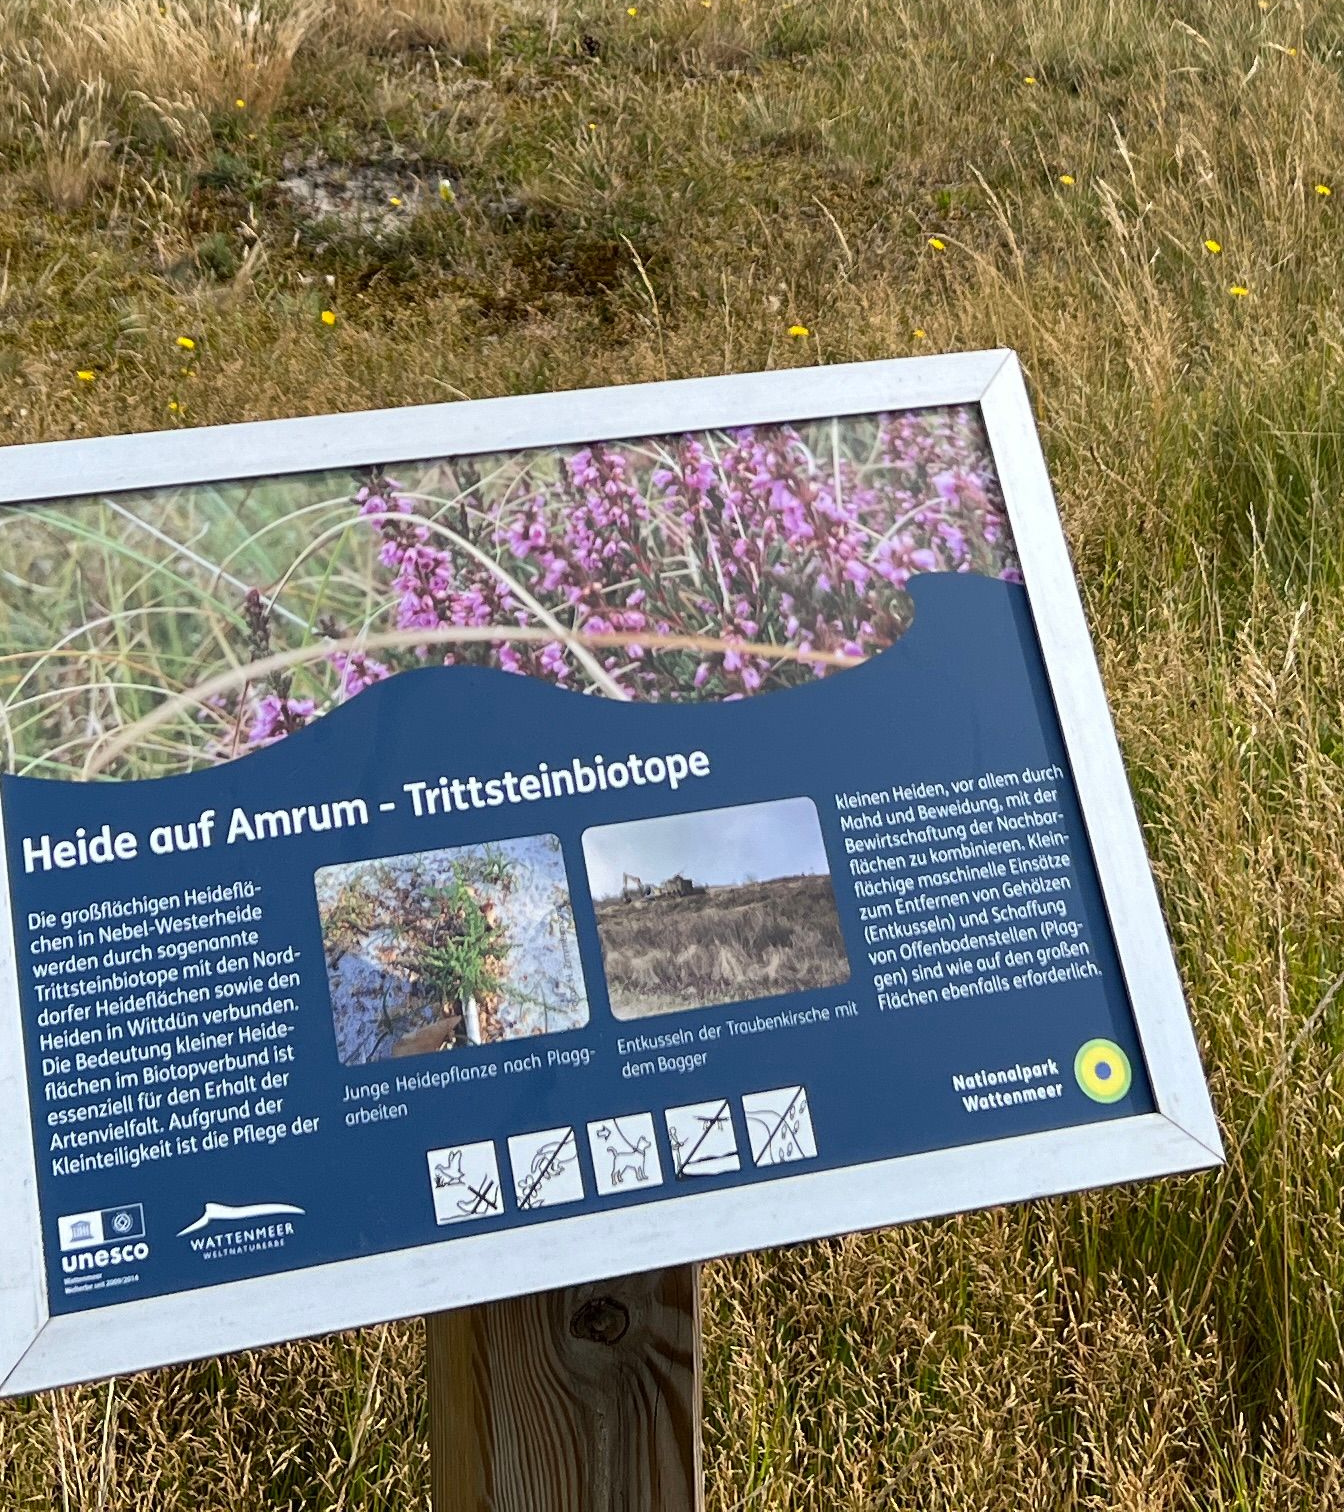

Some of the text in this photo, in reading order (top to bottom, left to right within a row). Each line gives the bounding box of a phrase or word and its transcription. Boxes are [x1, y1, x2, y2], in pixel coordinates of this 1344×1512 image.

[835, 764, 1064, 810] kleinen Heiden, vor allem durch
[841, 788, 1057, 832] Mahd und Beweidung, mit der
[23, 825, 138, 873] Heide
[150, 810, 215, 854] auf
[227, 799, 369, 844] Amrum
[403, 751, 710, 816] Trittsteinbiotope
[845, 811, 1064, 854] Bewirtschaftung der Nachbar-
[850, 831, 1069, 876] flächen zu kombinieren. Klein-
[854, 854, 1071, 898] flächige maschinelle Einsätze
[28, 881, 261, 930] Die großflächigen Heideflä-
[859, 877, 1071, 921] zum Entfernen von Gehölzen
[865, 900, 1067, 945] (Entkusseln) und Schaffung
[31, 904, 262, 954] chen in Nebel-Westerheide
[868, 920, 1083, 965] von Offenbodenstellen (Plag-
[33, 931, 258, 978] werden durch sogenannte
[34, 946, 301, 1002] Trittsteinbiotope mit den Nord-
[874, 941, 1090, 992] gen) sind wie auf den großen
[38, 972, 300, 1027] dorfer Heideflächen sowie den
[878, 960, 1102, 1011] Flächen ebenfalls erforderlich.
[40, 997, 299, 1051] Heiden in Wittdün verbunden.
[617, 1001, 858, 1055] Entkusseln der Traubenkirsche mit
[42, 1021, 294, 1076] Die Bedeutung kleiner Heide-
[622, 1053, 707, 1079] dem Bagger
[45, 1045, 295, 1101] flächen im Biotopverbund ist
[343, 1049, 595, 1102] Junge Heidepflanze nach Plagg-
[953, 1059, 1059, 1091] Nationalpark
[48, 1071, 289, 1126] essenziell für den Erhalt der
[345, 1104, 408, 1127] arbeiten
[962, 1084, 1063, 1112] Wattenmeer
[50, 1097, 283, 1151] Artenvielfalt. Aufgrund der
[52, 1116, 319, 1176] Kleinteiligkeit ist die Pflege der
[62, 1243, 149, 1273] unesco
[191, 1223, 294, 1251] WATTENMEER
